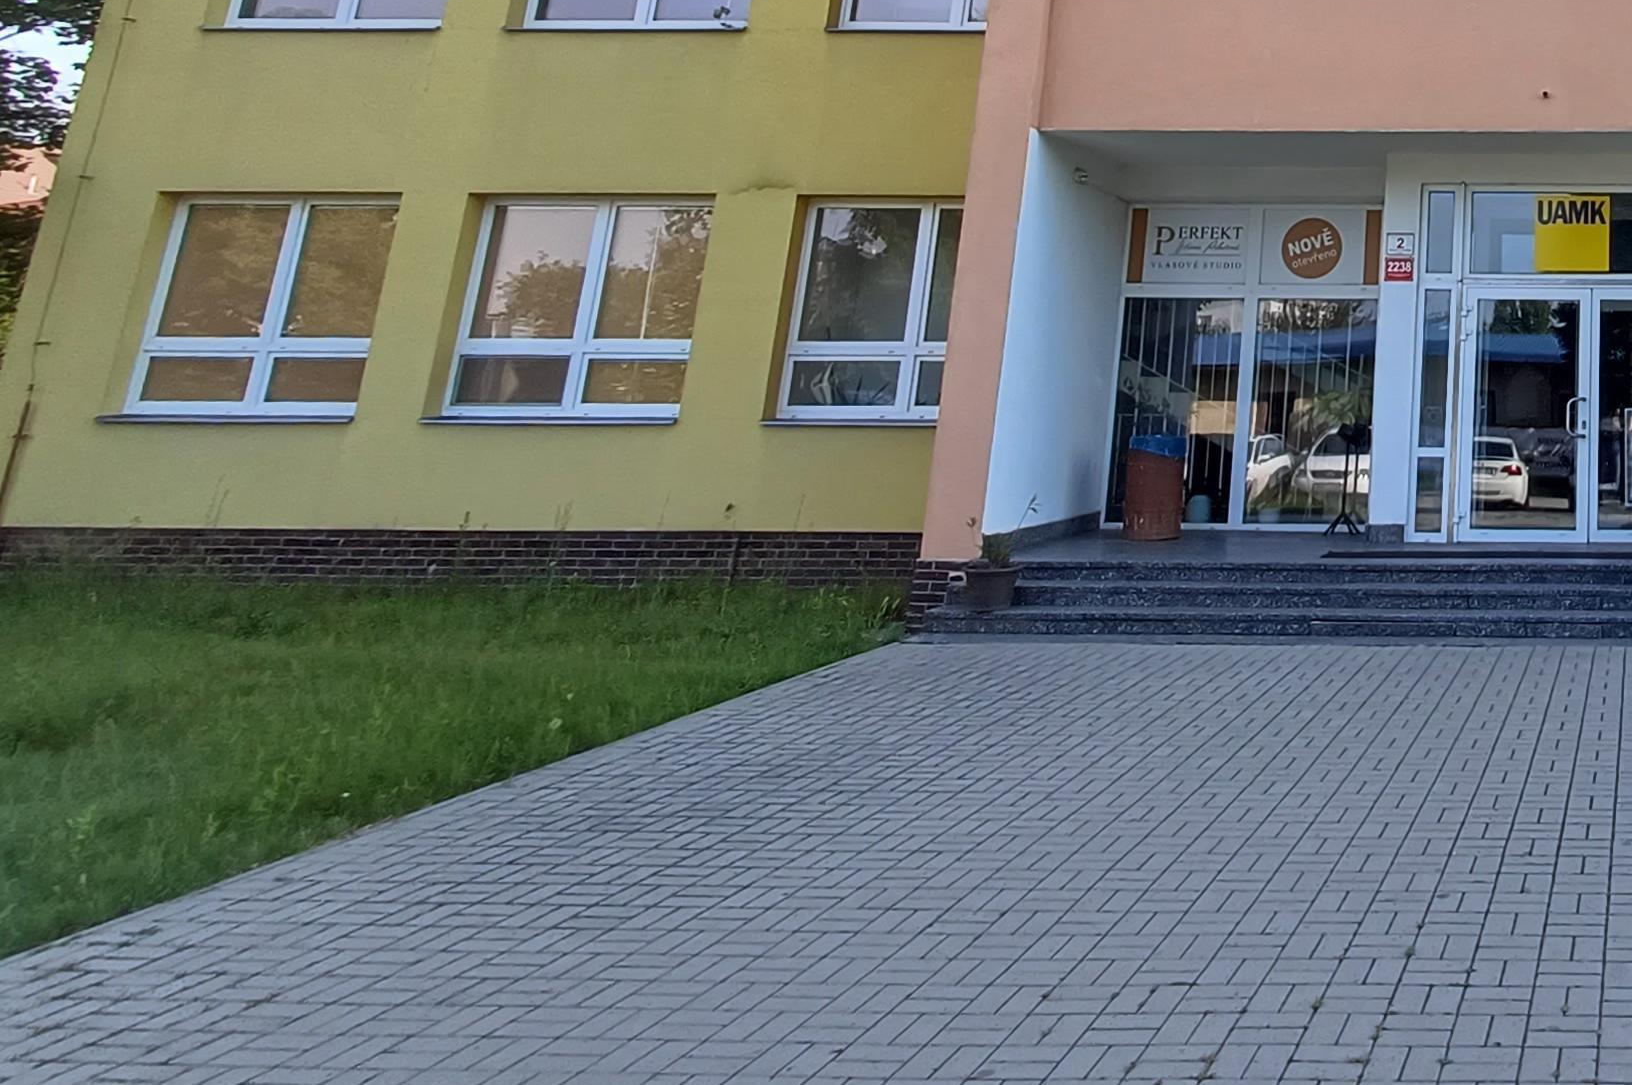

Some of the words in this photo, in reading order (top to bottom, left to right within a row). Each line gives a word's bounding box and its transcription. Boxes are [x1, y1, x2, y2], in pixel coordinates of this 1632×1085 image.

[1537, 200, 1606, 225] UAMK
[1152, 226, 1244, 255] PERFEKT
[1287, 227, 1335, 256] NOVĚ
[1396, 237, 1404, 249] 2
[1203, 261, 1242, 269] STUDIO
[1292, 249, 1337, 268] otevřeno
[1387, 261, 1412, 272] 2238
